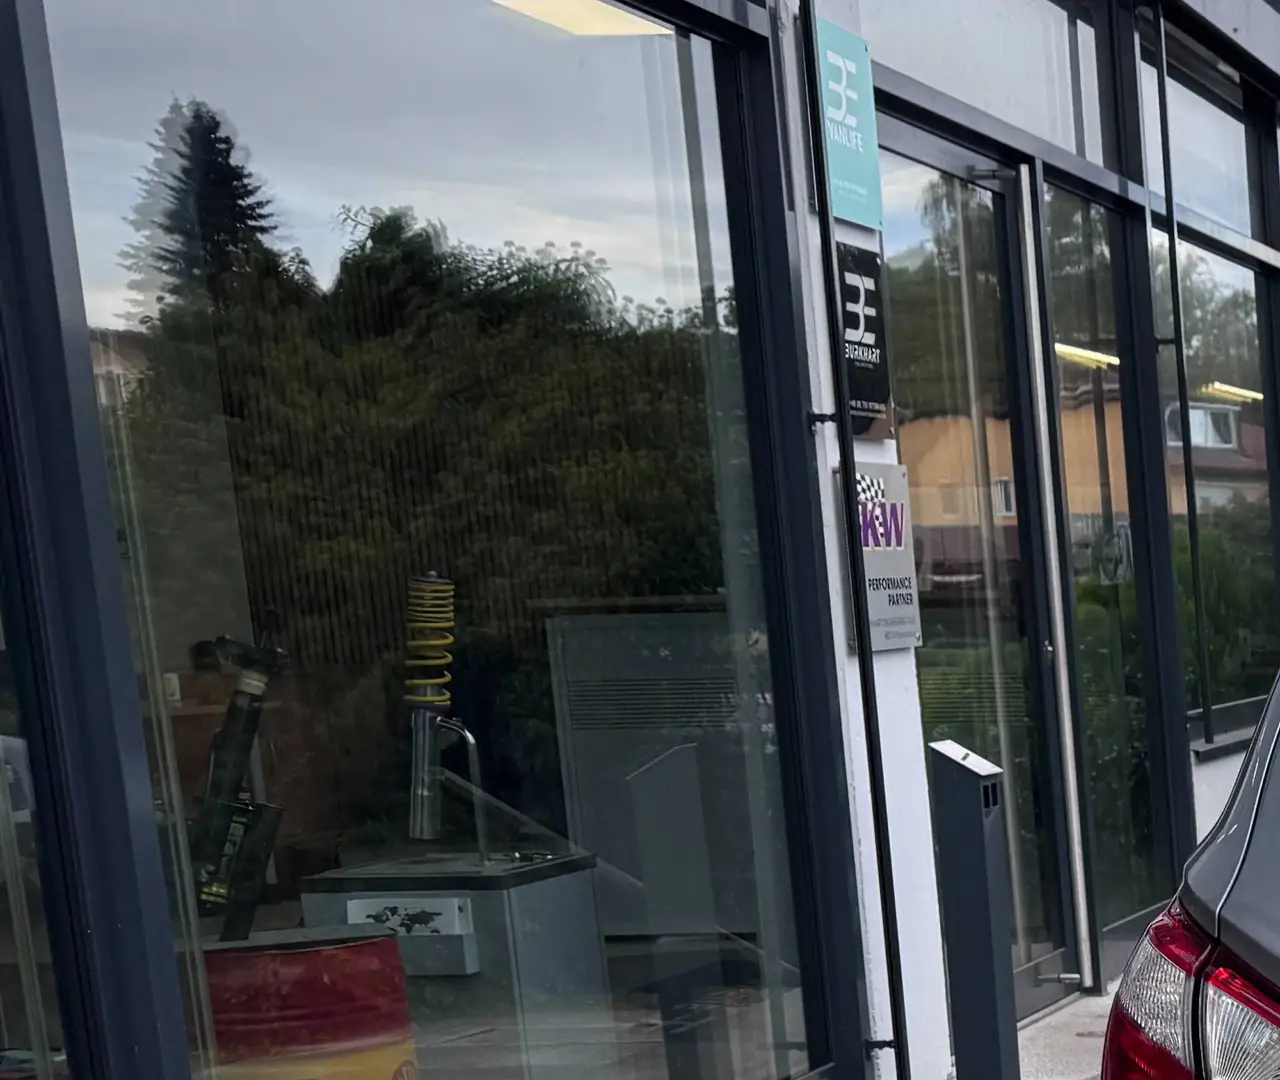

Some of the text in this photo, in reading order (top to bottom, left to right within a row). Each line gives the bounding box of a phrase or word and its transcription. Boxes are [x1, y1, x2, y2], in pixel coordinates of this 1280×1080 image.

[860, 500, 906, 550] KW
[867, 576, 912, 591] PERFORMANCE
[888, 593, 913, 606] PARTNER
